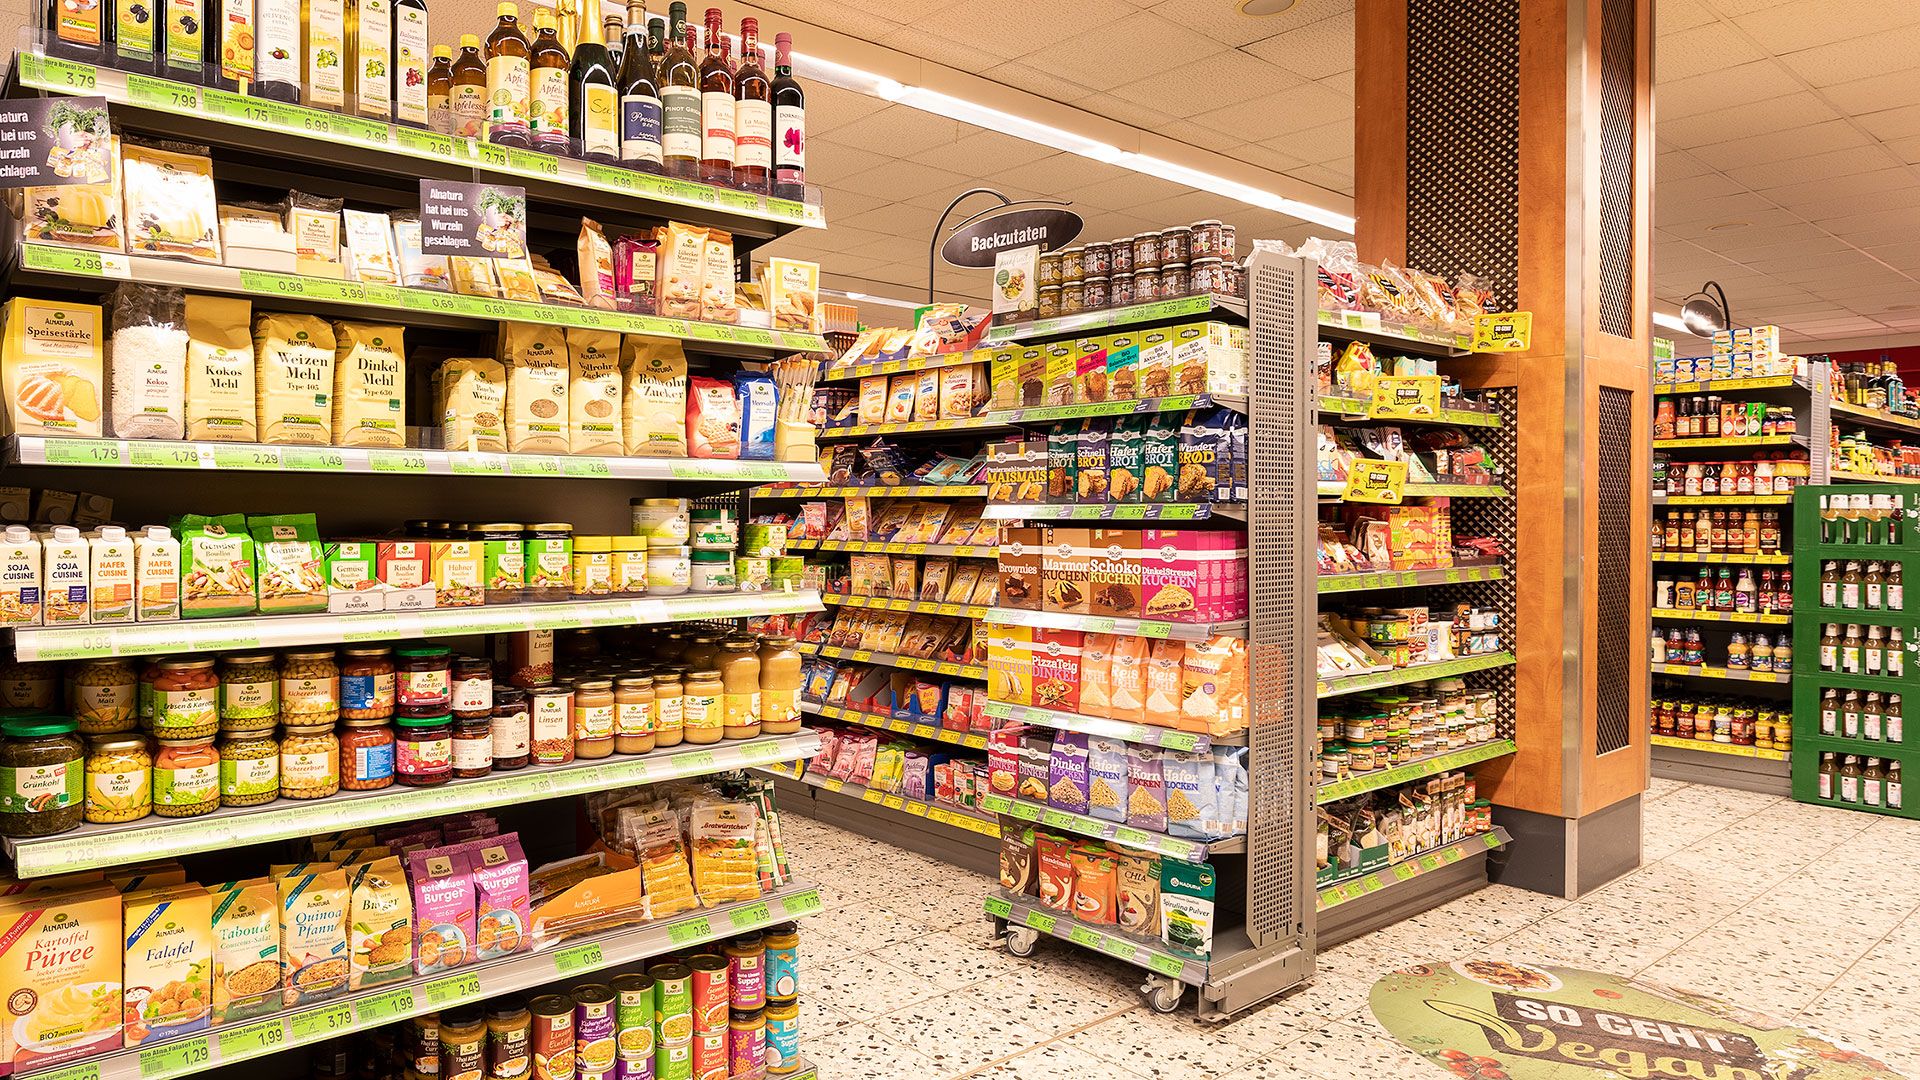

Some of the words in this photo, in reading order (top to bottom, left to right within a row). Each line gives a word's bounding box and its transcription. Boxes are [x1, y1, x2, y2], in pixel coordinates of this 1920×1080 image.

[66, 72, 95, 88] 3,79
[172, 93, 197, 108] 7,99
[244, 107, 268, 122] 1,75
[305, 118, 328, 132] 6,99
[1, 129, 15, 141] bei
[18, 131, 36, 140] uns
[365, 130, 388, 144] 2,99
[0, 147, 30, 159] urzeln
[430, 142, 451, 155] 2,69
[485, 151, 505, 165] 2,79
[539, 163, 558, 174] 1,49
[613, 176, 631, 188] 6,99
[430, 188, 464, 201] Alnatura
[658, 184, 674, 197] 4,99
[699, 191, 715, 202] 4,99
[425, 204, 439, 215] hat
[440, 205, 453, 216] bei
[454, 208, 468, 217] uns
[744, 199, 759, 210] 2,99
[790, 207, 803, 217] 3,99
[431, 219, 463, 232] Wurzeln
[424, 235, 471, 248] geschlagen.
[971, 225, 1047, 252] Backzutaten
[73, 257, 103, 271] 2,99
[278, 281, 303, 292] 0,99
[341, 288, 364, 298] 3,99
[432, 298, 454, 309] 0,69
[485, 304, 506, 314] 0,69
[1162, 305, 1177, 313] 2,99
[1195, 299, 1210, 309] 2,99
[534, 310, 554, 320] 0,69
[581, 315, 600, 325] 0,99
[45, 318, 75, 327] ALNATURA
[27, 326, 91, 340] Speisestärke
[669, 324, 687, 334] 2,29
[716, 329, 732, 339] 3,29
[277, 351, 328, 367] Weizen
[525, 359, 560, 369] Vollrohr
[206, 365, 242, 376] Kokos
[358, 358, 398, 373] Dinkel
[578, 362, 613, 371] Vollrohr
[286, 367, 320, 380] Mehl
[528, 369, 558, 377] Zucker
[582, 370, 612, 379] Zucker
[210, 379, 238, 389] Mehl
[363, 373, 393, 386] Mehl
[287, 383, 304, 391] Type
[643, 386, 684, 399] Zucker
[92, 447, 118, 460] 1,79
[1077, 448, 1106, 457] Schnell
[1110, 446, 1139, 456] Hafer
[1145, 444, 1174, 454] Hafer
[1178, 442, 1216, 453] Wunder
[172, 451, 198, 462] 1,79
[253, 454, 278, 464] 2,29
[319, 456, 342, 466] 1,49
[1049, 457, 1073, 468] BROT
[1078, 456, 1105, 467] BROT
[1110, 455, 1139, 467] BROT
[1145, 453, 1174, 464] BROT
[404, 457, 425, 470] 2,29
[483, 461, 501, 470] 1,99
[539, 462, 557, 471] 1,99
[590, 461, 608, 472] 2,69
[394, 564, 416, 572] Rinder
[999, 562, 1037, 574] Brownies
[1043, 559, 1090, 572] Marmor
[1090, 560, 1141, 575] Schoko
[3, 572, 35, 580] CUISINE
[1043, 571, 1089, 582] KUCHEN
[1090, 573, 1141, 585] KUCHEN
[1142, 575, 1196, 588] KUCHEN
[1155, 626, 1169, 634] 2,99
[1032, 656, 1077, 673] PizzaTeig
[1032, 666, 1077, 682] DINKEL
[1112, 665, 1138, 679] Reis
[1148, 667, 1177, 680] Reis
[988, 760, 1017, 771] DINKEL
[1050, 756, 1085, 771] Dinkel
[1019, 767, 1049, 779] DINKEL
[1050, 768, 1085, 779] FLOCKEN
[531, 778, 550, 794] 2,99
[480, 870, 497, 880] Rote
[1124, 870, 1147, 883] CHIA
[422, 884, 439, 893] Rote
[483, 875, 520, 890] Burger
[424, 889, 465, 905] Burger
[804, 896, 821, 909] 0,79
[997, 905, 1009, 914] 3,49
[1162, 898, 1188, 912] Spirulina
[1189, 905, 1210, 917] Pulver
[295, 909, 342, 925] Quinoa
[752, 908, 771, 921] 2,99
[42, 919, 80, 933] ALNATURA
[1041, 917, 1054, 928] 6,99
[155, 927, 185, 938] ALNATURA
[220, 923, 271, 941] Taboulé
[694, 923, 712, 937] 2,69
[35, 930, 89, 950] Kartoffel
[1087, 935, 1100, 945] 4,99
[145, 940, 195, 961] Falafel
[1121, 947, 1135, 957] 6,99
[24, 944, 95, 972] Püree
[583, 950, 603, 966] 0,99
[1166, 962, 1181, 973] 6,99
[737, 977, 760, 985] Suppe
[459, 980, 481, 996] 2,49
[391, 996, 414, 1014] 1,99
[328, 1011, 352, 1028] 3,79
[1515, 999, 1582, 1027] SO
[1594, 1012, 1723, 1054] GEHT
[258, 1028, 283, 1046] 1,99
[169, 1043, 190, 1052] Falafel
[508, 1047, 524, 1055] Curry
[182, 1047, 209, 1065] 1,29
[461, 1061, 477, 1069] Curry
